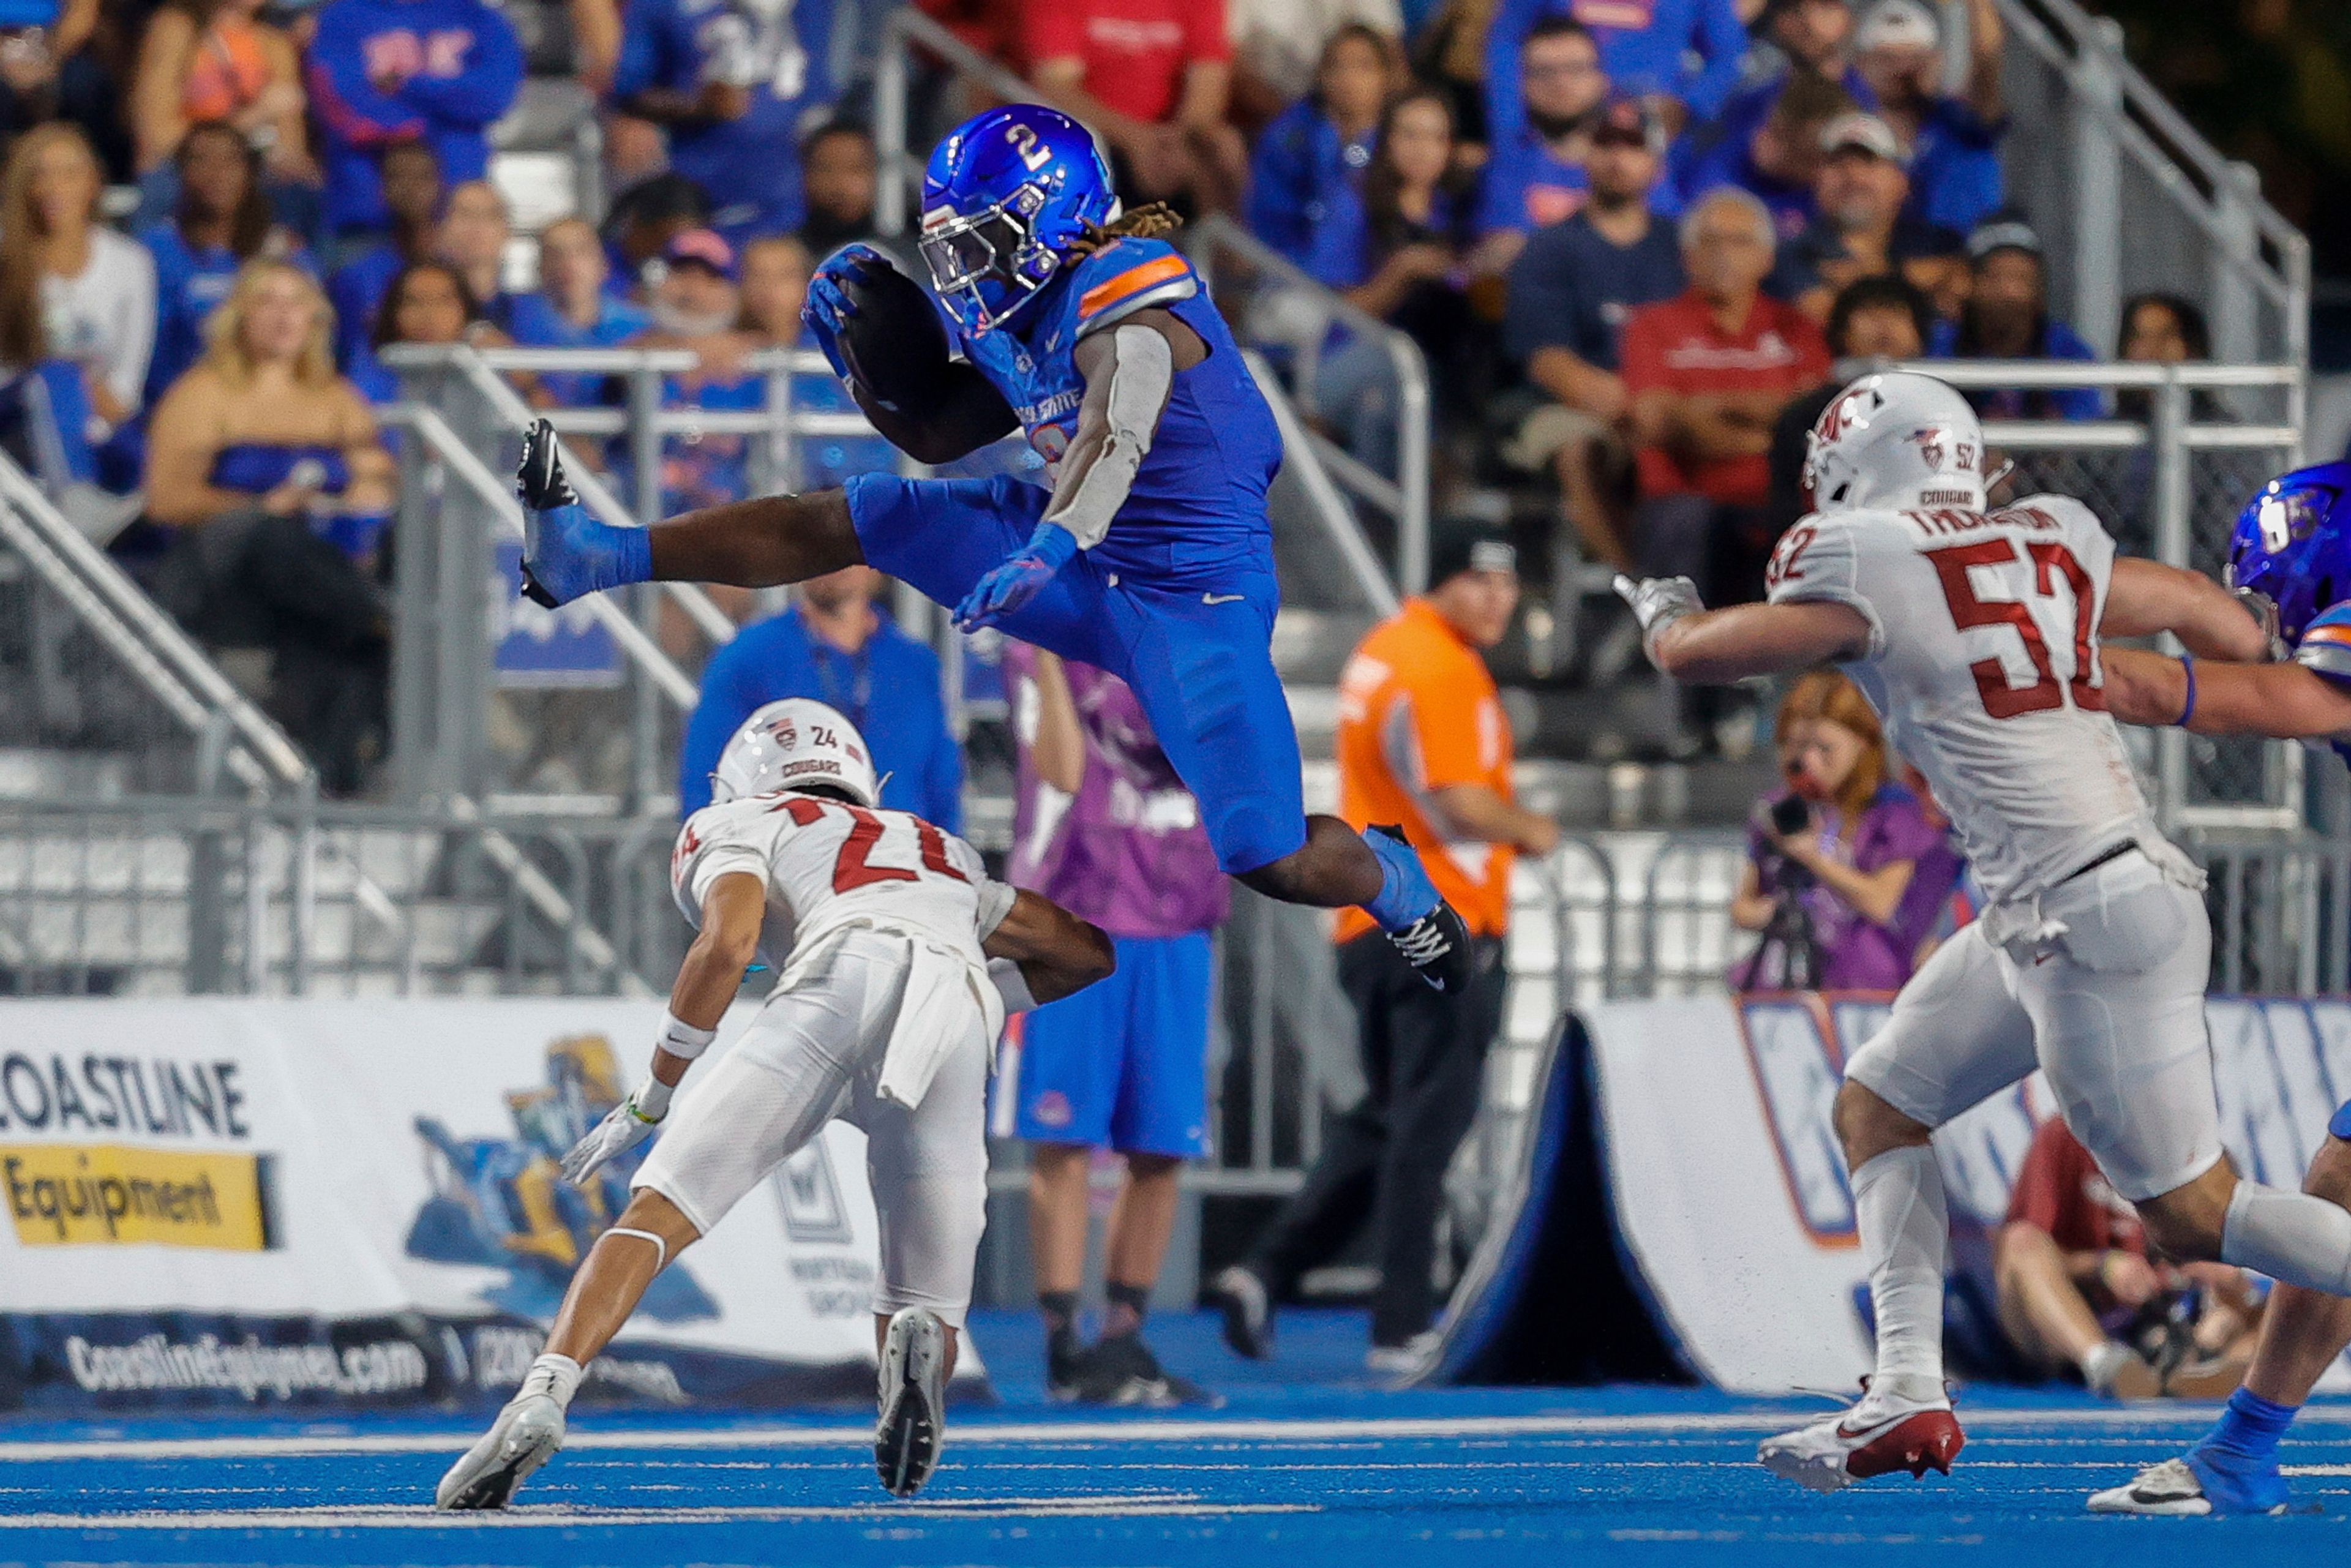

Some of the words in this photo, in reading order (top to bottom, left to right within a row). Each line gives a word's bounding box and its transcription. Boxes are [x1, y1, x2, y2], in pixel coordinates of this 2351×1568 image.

[1005, 123, 1052, 172] 2
[1920, 538, 2105, 718] 52
[810, 726, 838, 749] 24
[781, 759, 842, 778] COUGARS
[0, 1051, 250, 1139] OASTLINE
